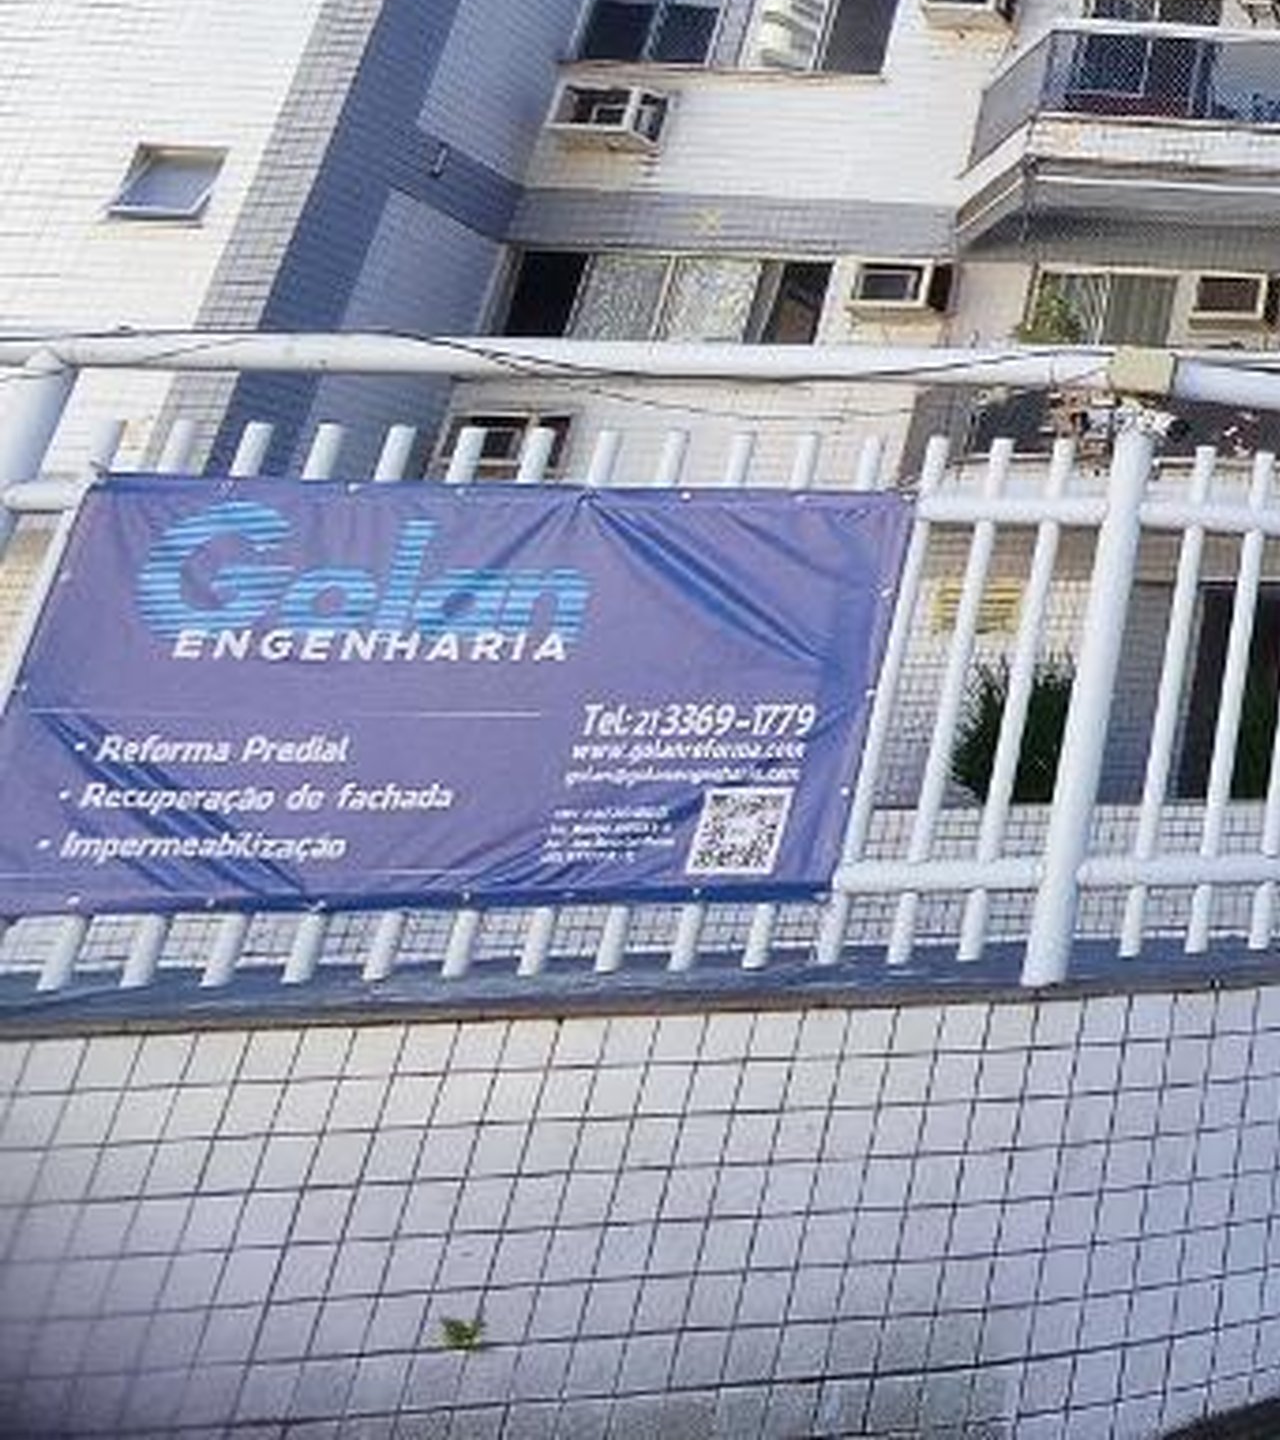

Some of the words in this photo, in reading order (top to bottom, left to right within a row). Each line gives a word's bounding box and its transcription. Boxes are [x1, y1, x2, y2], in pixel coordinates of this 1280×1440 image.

[136, 500, 590, 640] Golan
[171, 628, 568, 662] ENGENHARIA
[95, 734, 231, 762] Reforma
[241, 733, 350, 762] Predial
[77, 781, 275, 816] Recuperação
[285, 783, 325, 811] de
[336, 782, 453, 811] fachada
[58, 830, 348, 864] Impermeabilização
